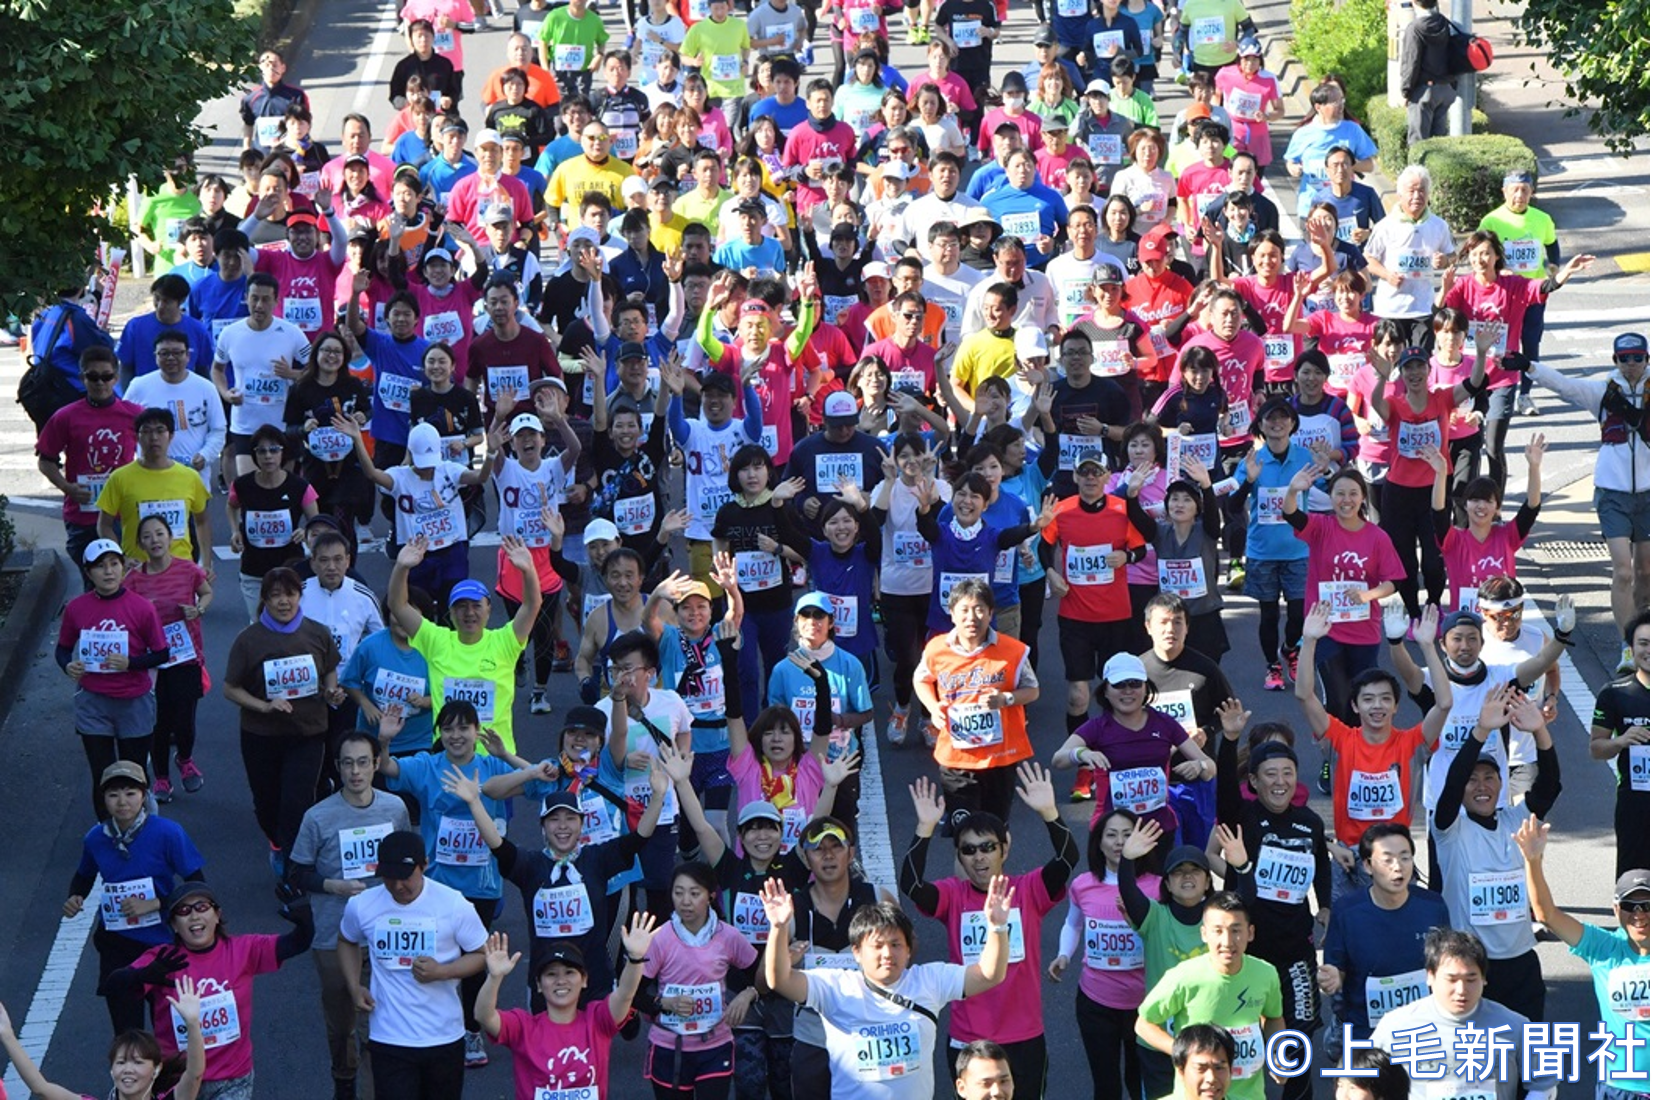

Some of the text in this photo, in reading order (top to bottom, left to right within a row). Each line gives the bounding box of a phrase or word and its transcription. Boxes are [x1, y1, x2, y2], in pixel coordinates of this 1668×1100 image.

[1510, 247, 1537, 260] 10878
[290, 307, 317, 320] 12165
[248, 378, 279, 392] 12465
[1405, 431, 1435, 447] 15239
[820, 454, 858, 467] ORIHIRO
[624, 504, 651, 522] 15163
[254, 520, 287, 534] 16289
[420, 521, 453, 538] 15545
[745, 557, 776, 580] 16127
[1073, 554, 1108, 571] 11943
[1167, 569, 1199, 585] 15774
[87, 640, 122, 658] 15669
[275, 668, 311, 688] 16430
[1115, 765, 1159, 783] ORIHIRO
[1359, 772, 1390, 783] Yakult
[1122, 780, 1159, 801] 15478
[1357, 784, 1395, 803] 10923
[447, 831, 484, 852] 16174
[1269, 862, 1308, 886] 11709
[1481, 884, 1520, 907] 11908
[543, 899, 582, 919] 15167
[386, 930, 425, 952] 11971
[1096, 932, 1136, 951] 15095
[1378, 985, 1421, 1010] 11970
[858, 1021, 912, 1038] ORIHIRO
[867, 1036, 913, 1061] 11313
